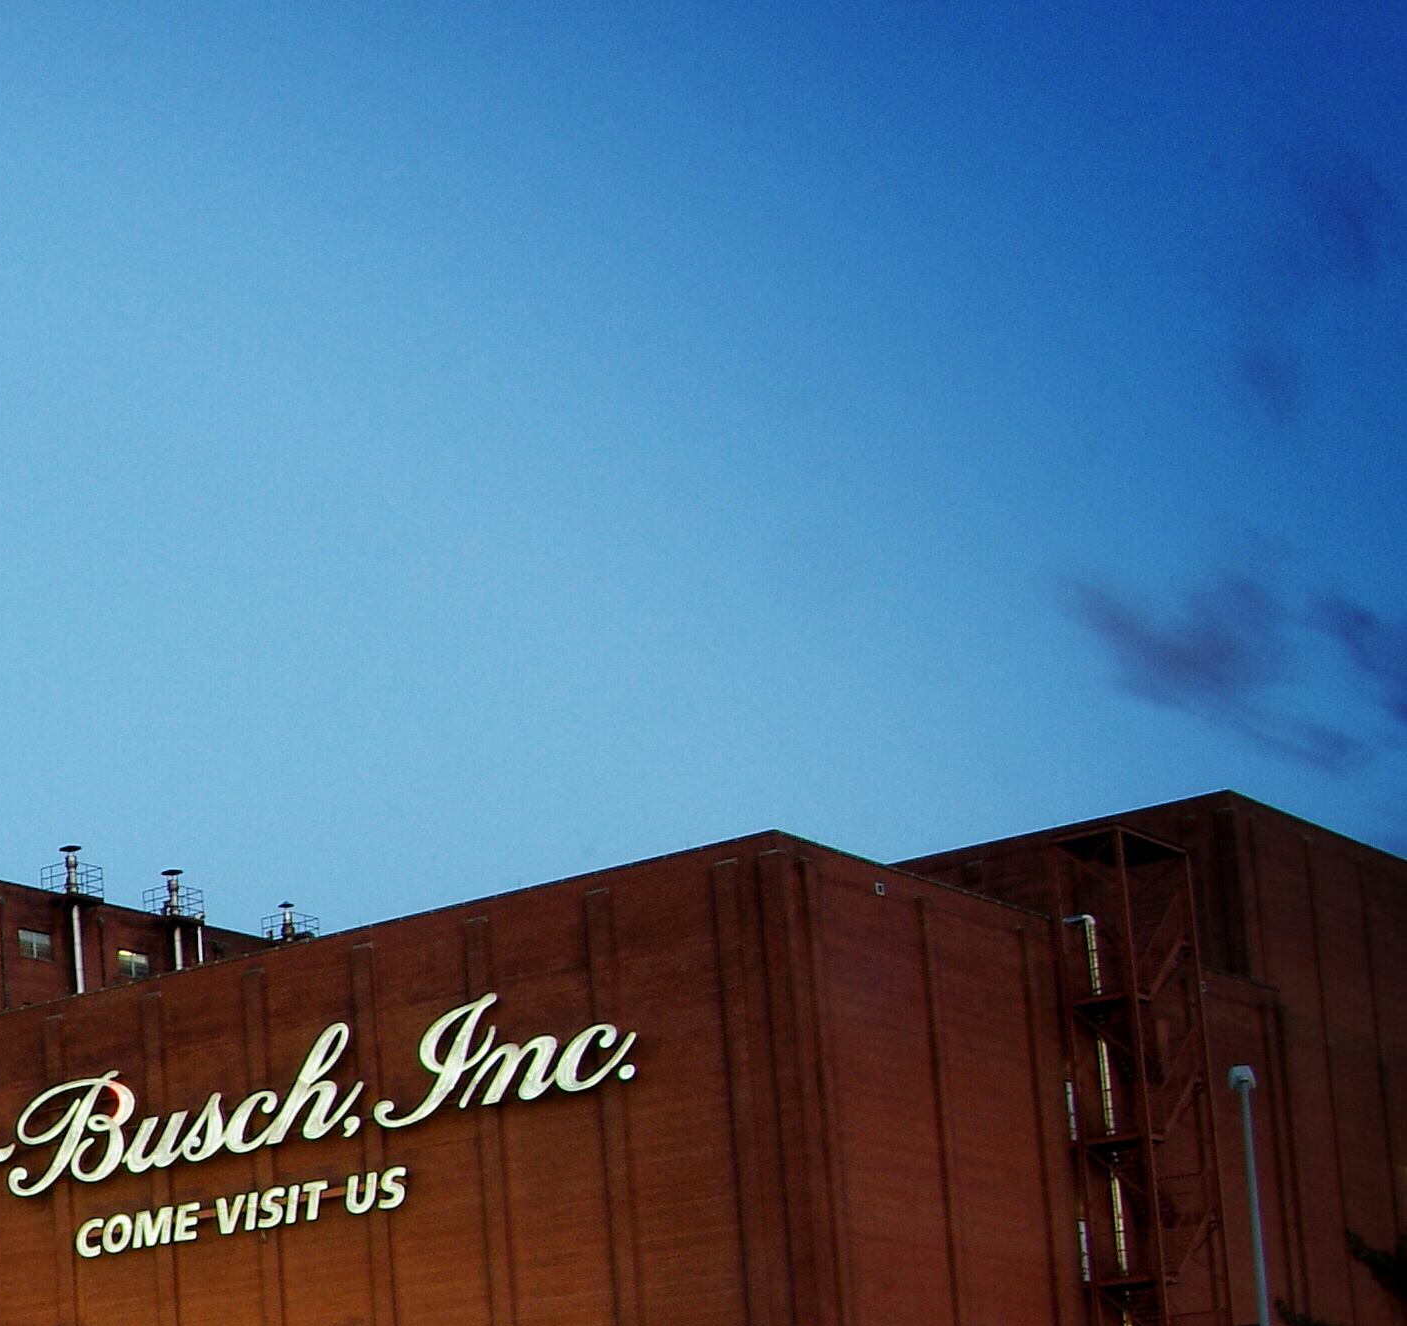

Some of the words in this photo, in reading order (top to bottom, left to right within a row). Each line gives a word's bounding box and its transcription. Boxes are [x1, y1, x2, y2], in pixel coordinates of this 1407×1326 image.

[374, 993, 637, 1128] Inc.
[76, 1201, 200, 1258] COME
[215, 1180, 328, 1235] VISIT
[345, 1166, 407, 1214] US
